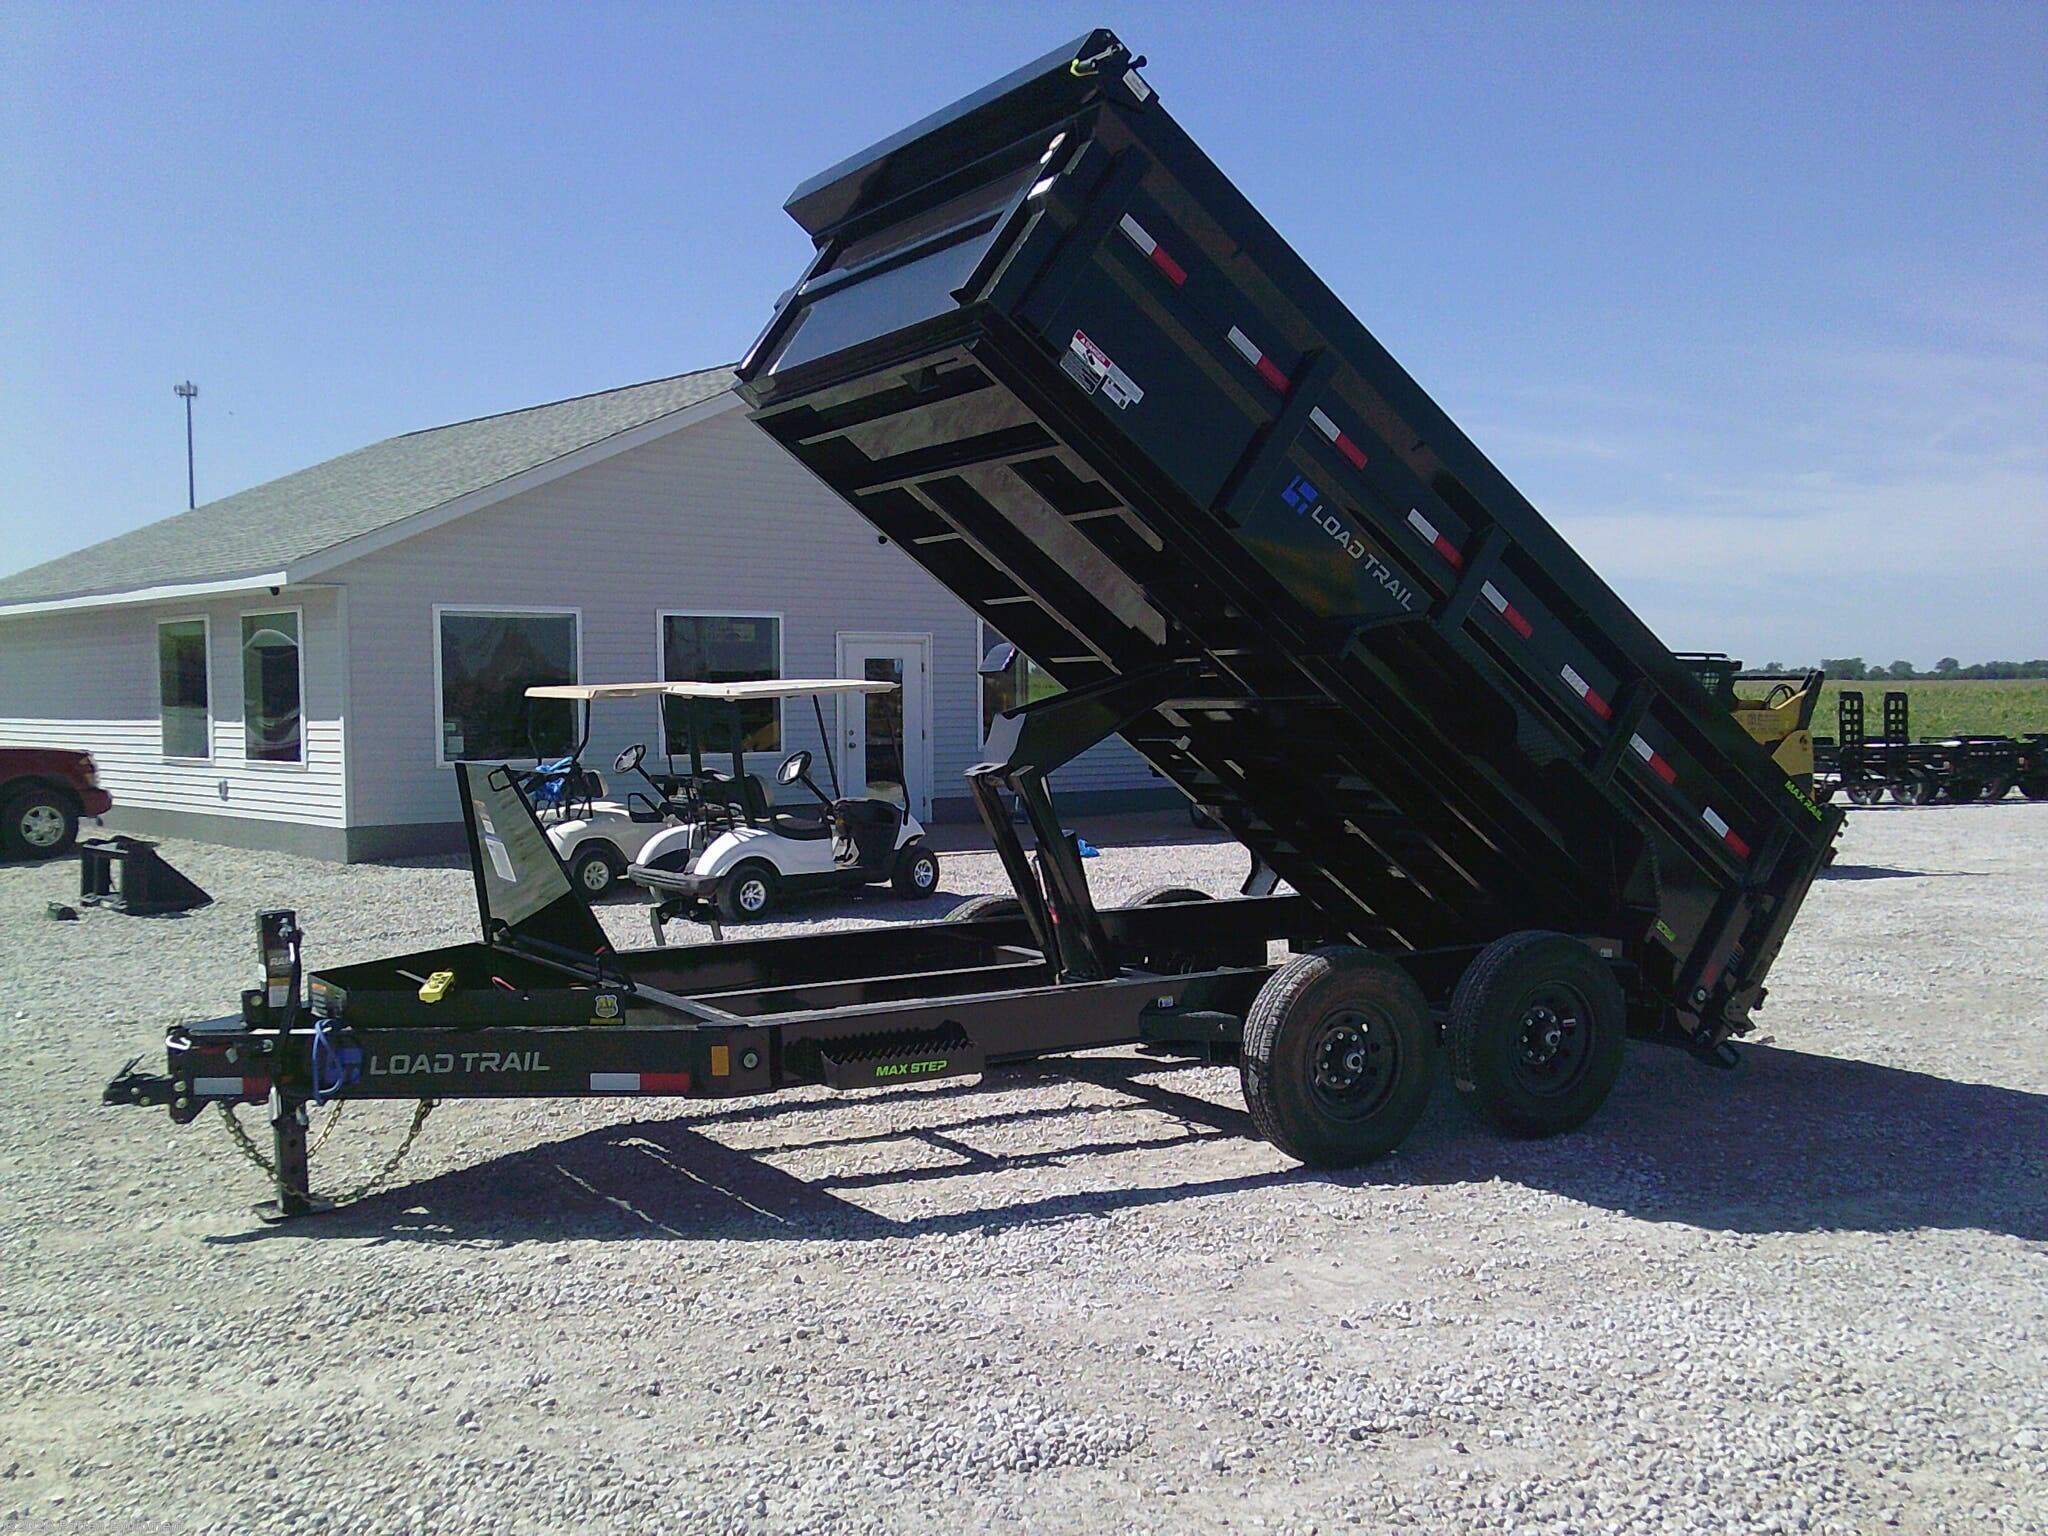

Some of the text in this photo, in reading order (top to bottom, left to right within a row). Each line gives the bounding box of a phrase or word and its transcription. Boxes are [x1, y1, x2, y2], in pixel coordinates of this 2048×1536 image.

[1311, 504, 1412, 612] LOAD TRAIL
[1784, 780, 1823, 821] MAX RAIL
[369, 1051, 550, 1075] LOAD TRAIL
[876, 1060, 948, 1077] MAX STEP
